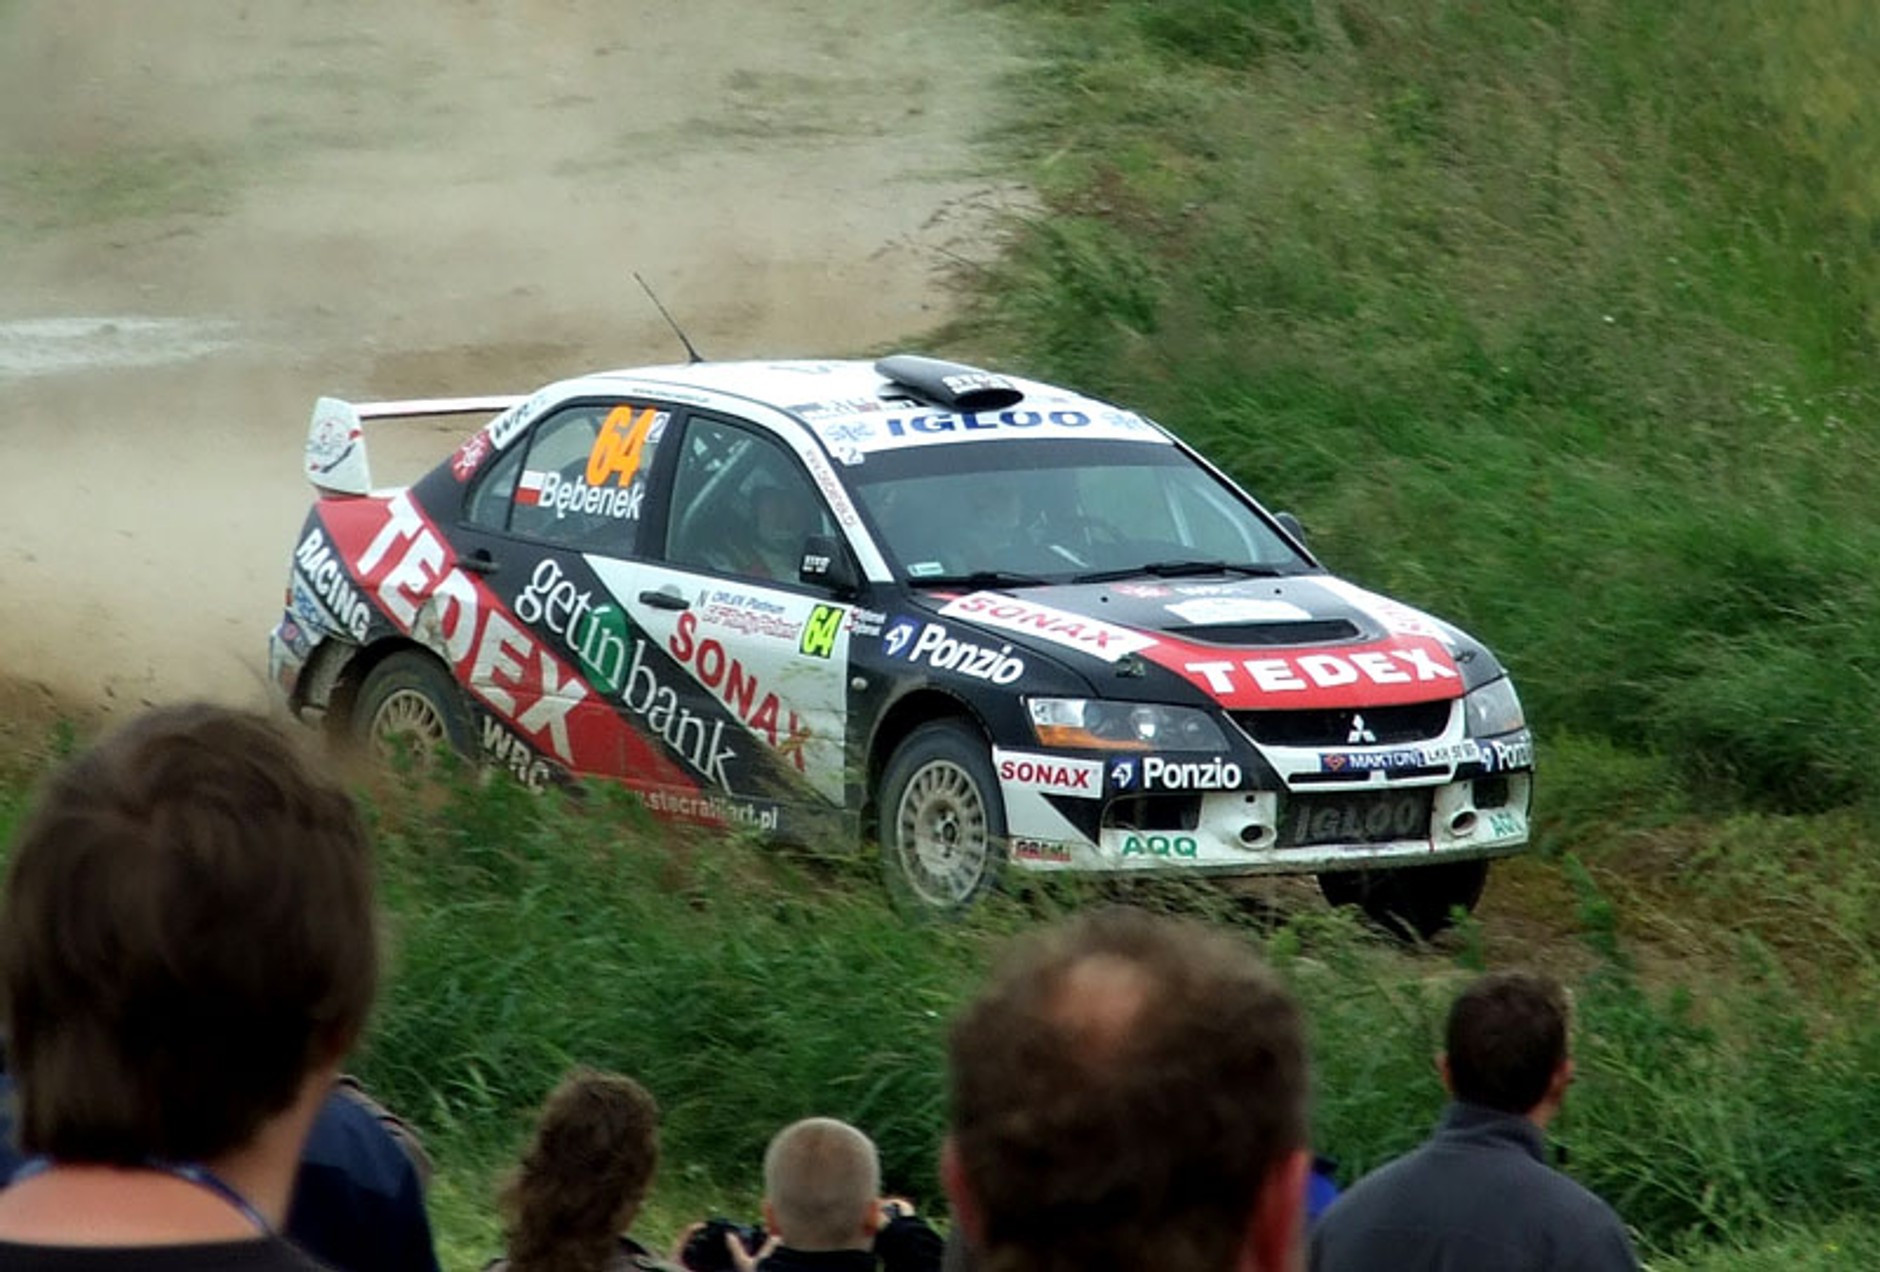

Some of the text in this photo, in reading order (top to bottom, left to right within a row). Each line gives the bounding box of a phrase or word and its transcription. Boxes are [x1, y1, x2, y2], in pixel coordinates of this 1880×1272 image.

[586, 403, 657, 487] 64
[887, 410, 1092, 437] IGLOO
[538, 472, 645, 521] Bębenek
[296, 528, 370, 643] RACING
[357, 491, 588, 766] TEDEX
[803, 605, 842, 658] 64
[958, 597, 1125, 649] SONAX
[908, 622, 1025, 685] Ponzio
[1184, 648, 1459, 694] TEDEX
[669, 610, 805, 772] SONAX
[1000, 760, 1091, 789] SONAX
[1142, 756, 1242, 790] Ponzio
[1121, 835, 1198, 858] AQQ
[1293, 800, 1418, 843] IGLOO
